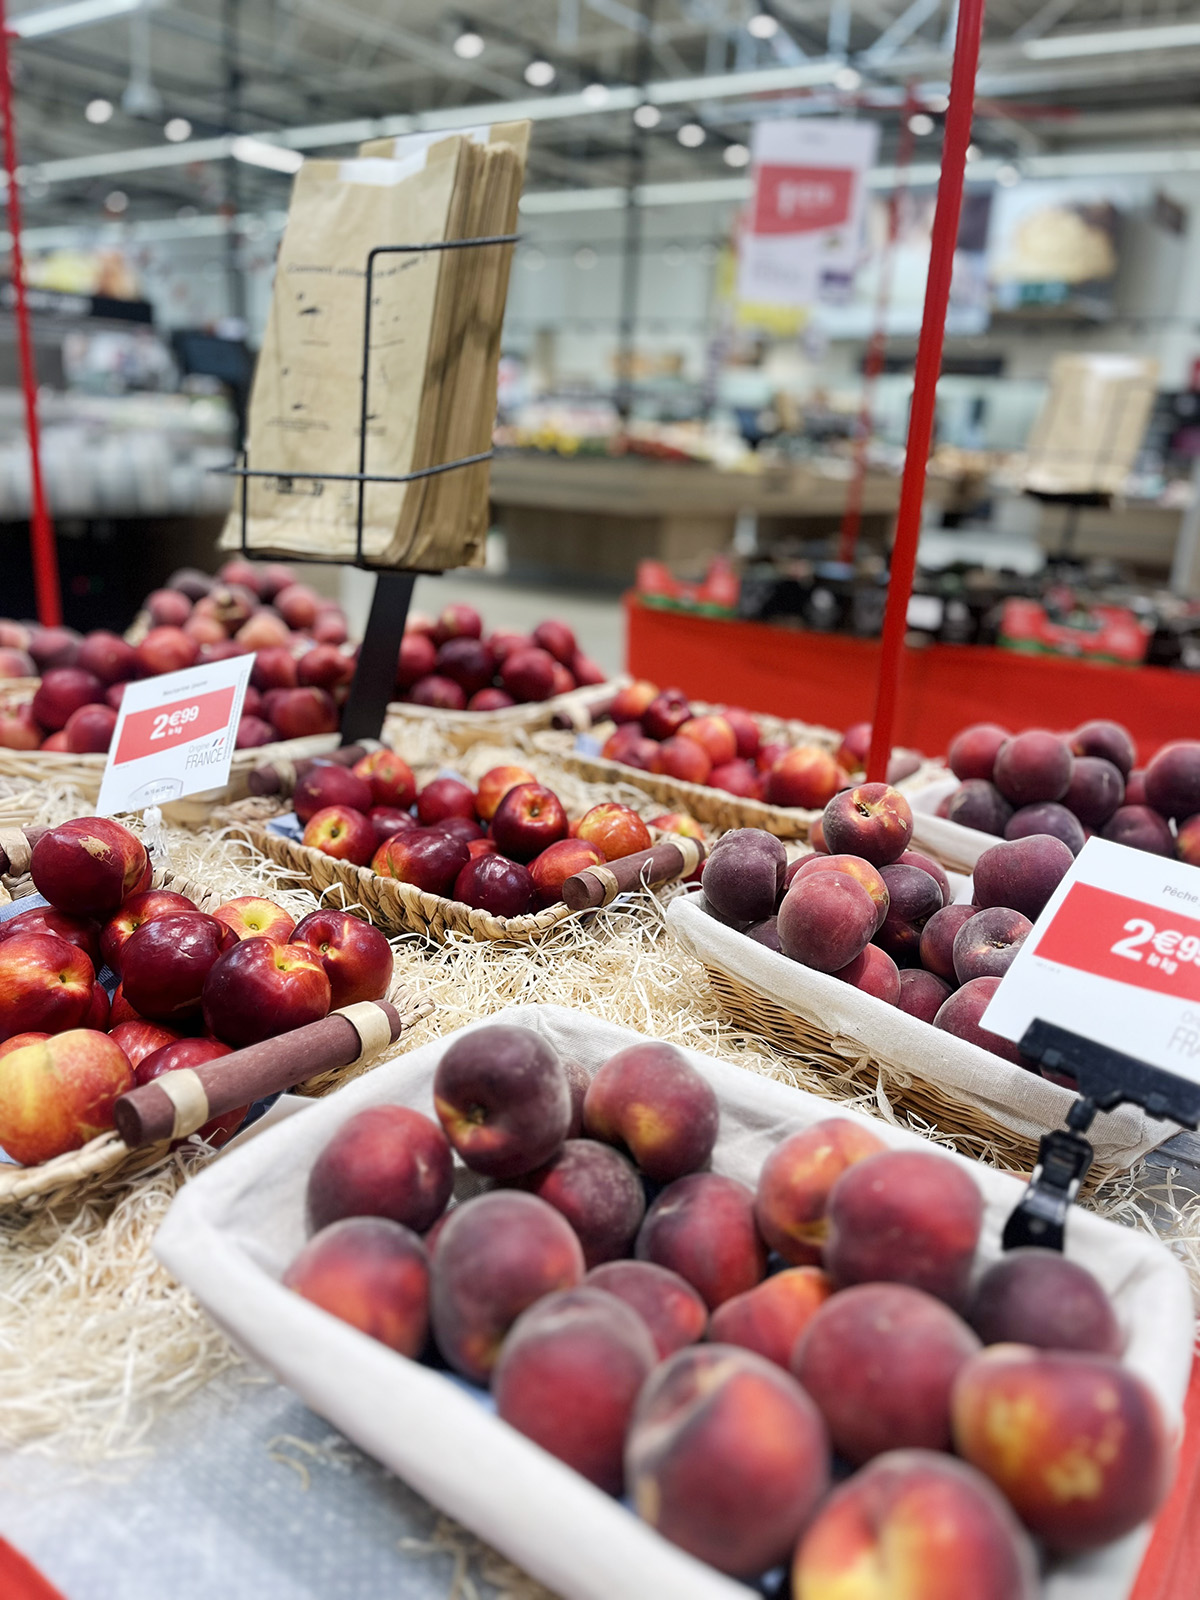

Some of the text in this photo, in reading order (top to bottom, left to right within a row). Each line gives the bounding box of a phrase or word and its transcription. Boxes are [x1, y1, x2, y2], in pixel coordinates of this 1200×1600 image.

[149, 705, 200, 741] 2€99
[184, 746, 224, 770] FRANCE
[1162, 885, 1199, 903] Pêche
[1111, 918, 1200, 966] 2€9
[1159, 957, 1179, 976] kg
